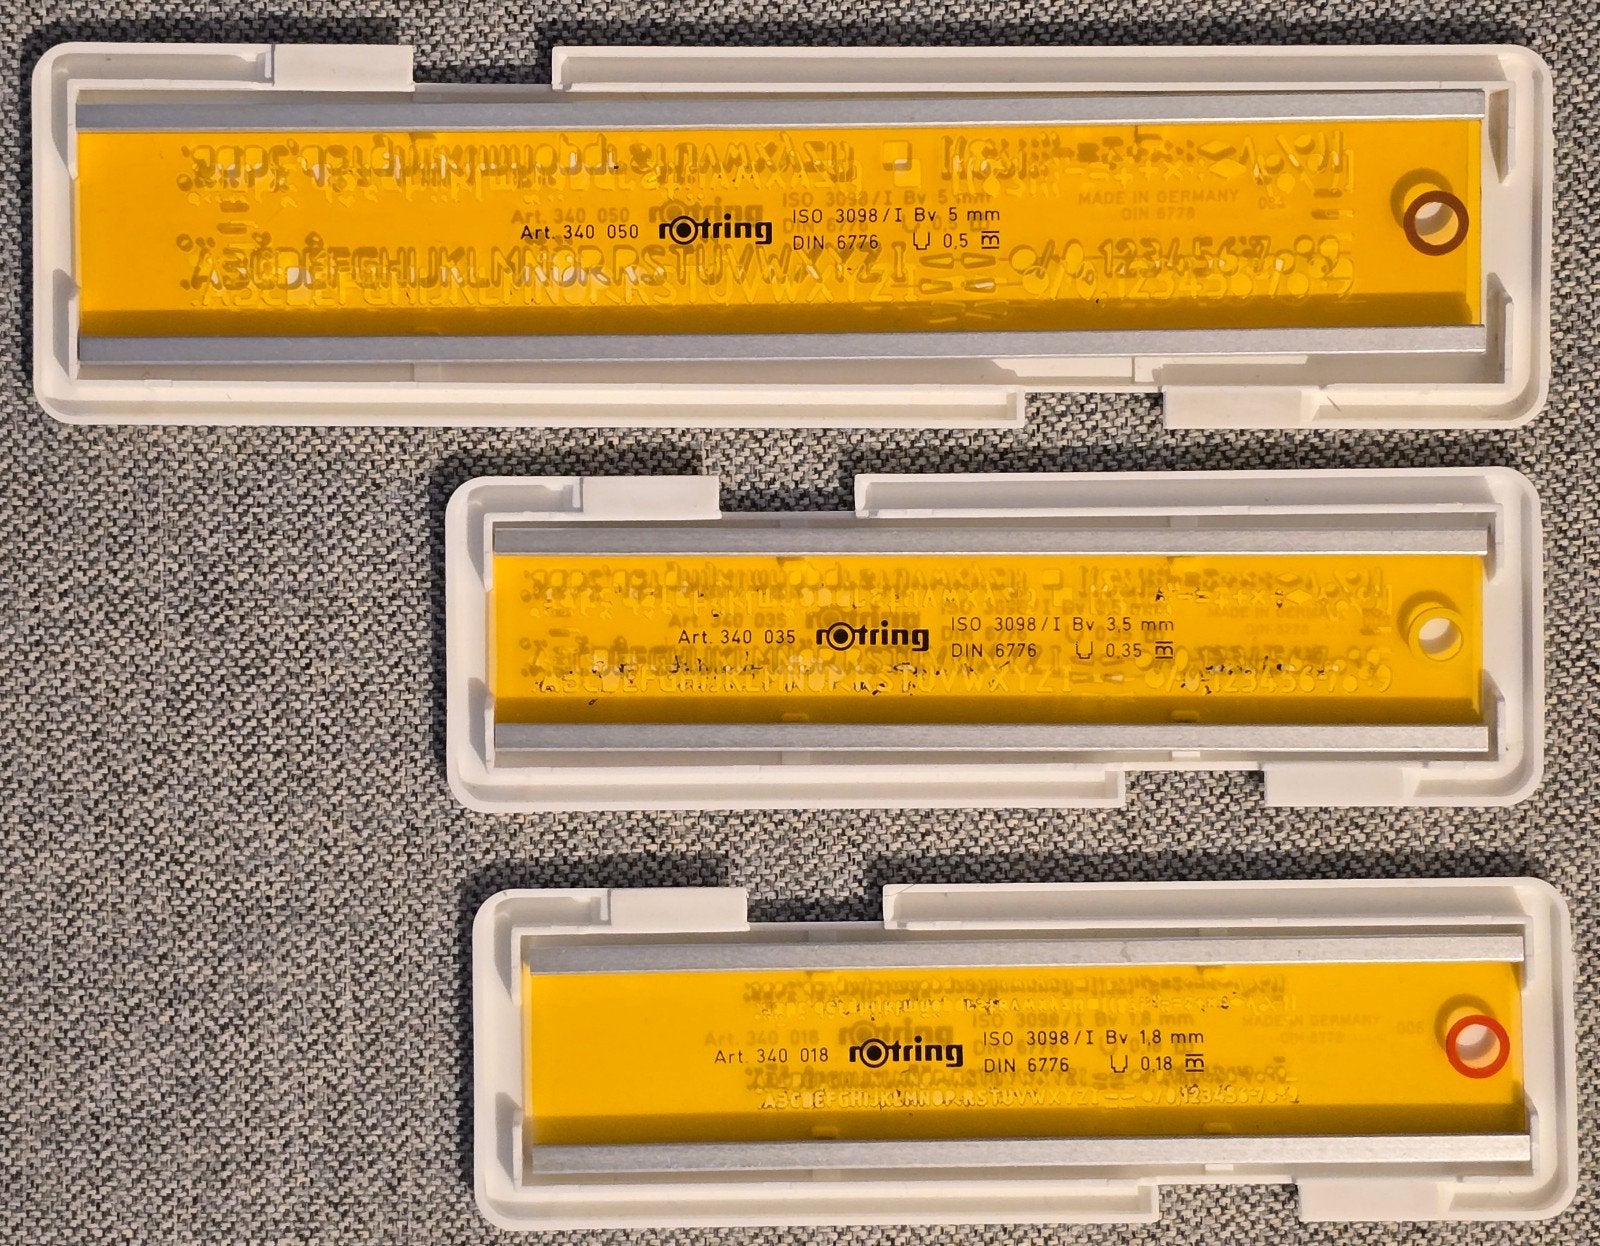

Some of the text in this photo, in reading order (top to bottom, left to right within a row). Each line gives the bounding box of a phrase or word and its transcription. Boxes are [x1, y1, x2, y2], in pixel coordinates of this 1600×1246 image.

[793, 208, 823, 224] ISO
[914, 207, 936, 222] Bv
[949, 206, 958, 222] 5
[967, 210, 1000, 221] mm
[520, 224, 639, 240] Art. 340 050
[658, 212, 773, 246] rotring
[793, 235, 824, 251] DIN
[837, 234, 879, 250] 6776
[943, 233, 969, 251] 0,5
[951, 616, 981, 632] ISO
[1073, 616, 1094, 631] Bv
[1107, 616, 1132, 633] 3,5
[1141, 620, 1174, 631] mm
[678, 629, 796, 644] Art. 340 035
[815, 619, 930, 652] rotring
[951, 643, 983, 658] DIN
[995, 643, 1037, 658] 6776
[983, 1031, 1013, 1046] ISO
[1106, 1029, 1128, 1045] Bv
[1140, 1029, 1162, 1047] 1,8
[1171, 1032, 1204, 1044] mm
[715, 1047, 829, 1064] Art. 340 018
[848, 1035, 964, 1069] rotring
[984, 1058, 1016, 1073] DIN
[1028, 1057, 1069, 1073] 6776
[1140, 1056, 1173, 1074] 0,18
